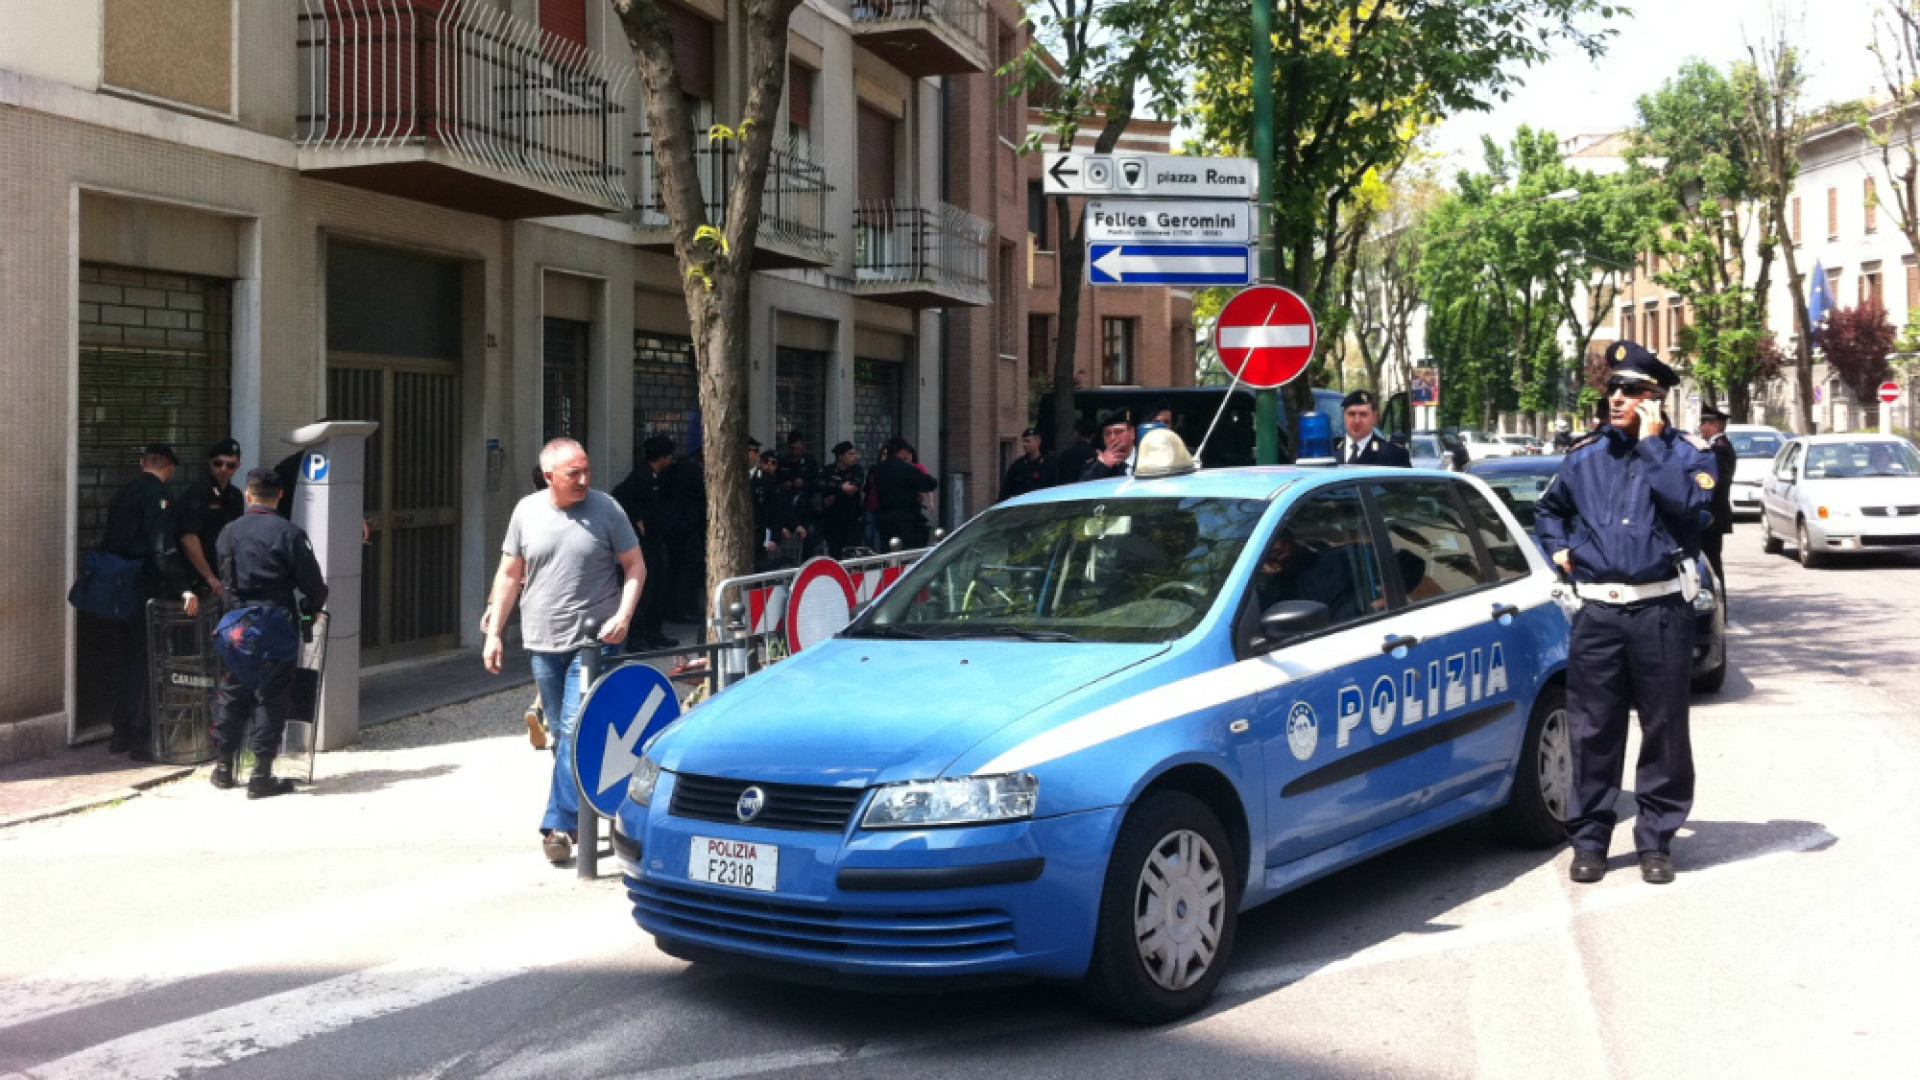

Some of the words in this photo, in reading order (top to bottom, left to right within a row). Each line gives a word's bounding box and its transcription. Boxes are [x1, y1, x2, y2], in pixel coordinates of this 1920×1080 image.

[1157, 171, 1197, 185] piazza
[1206, 169, 1246, 185] Roma
[1094, 212, 1147, 227] Felice
[1157, 212, 1235, 229] Geromini
[309, 453, 326, 480] P
[1336, 641, 1508, 749] POLIZIA
[708, 840, 757, 860] POLIZIA
[708, 859, 754, 886] F2318
